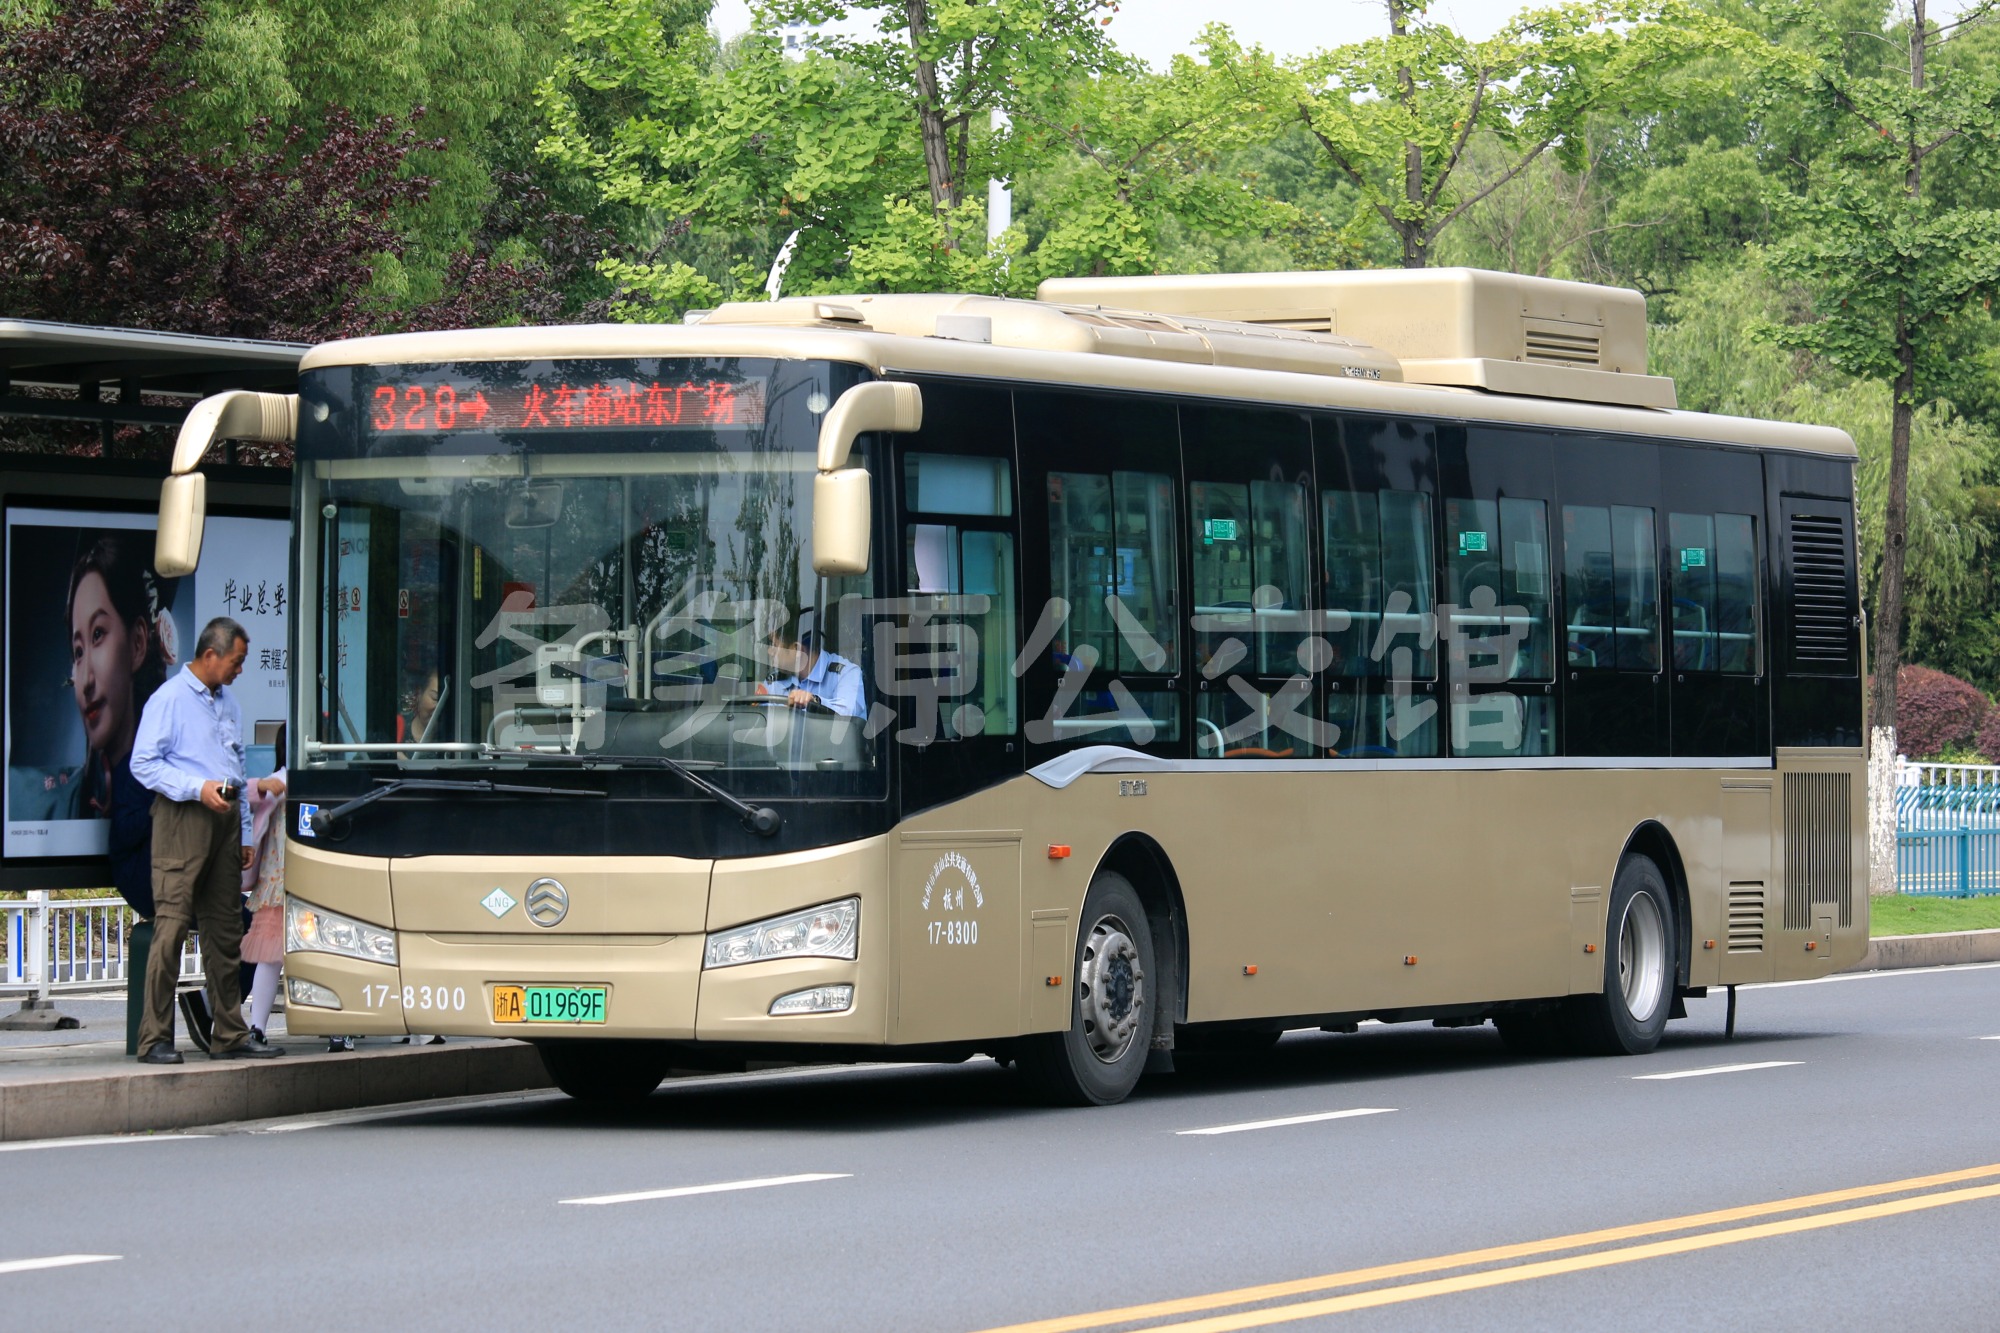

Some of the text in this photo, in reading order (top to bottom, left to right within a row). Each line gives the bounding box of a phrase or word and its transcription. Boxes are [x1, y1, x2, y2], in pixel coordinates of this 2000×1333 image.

[374, 382, 735, 430] 328 火车南站东广场
[223, 578, 287, 616] 毕业总要
[488, 897, 510, 909] LNG
[927, 921, 978, 945] 17-8300
[362, 984, 466, 1011] 17-8300
